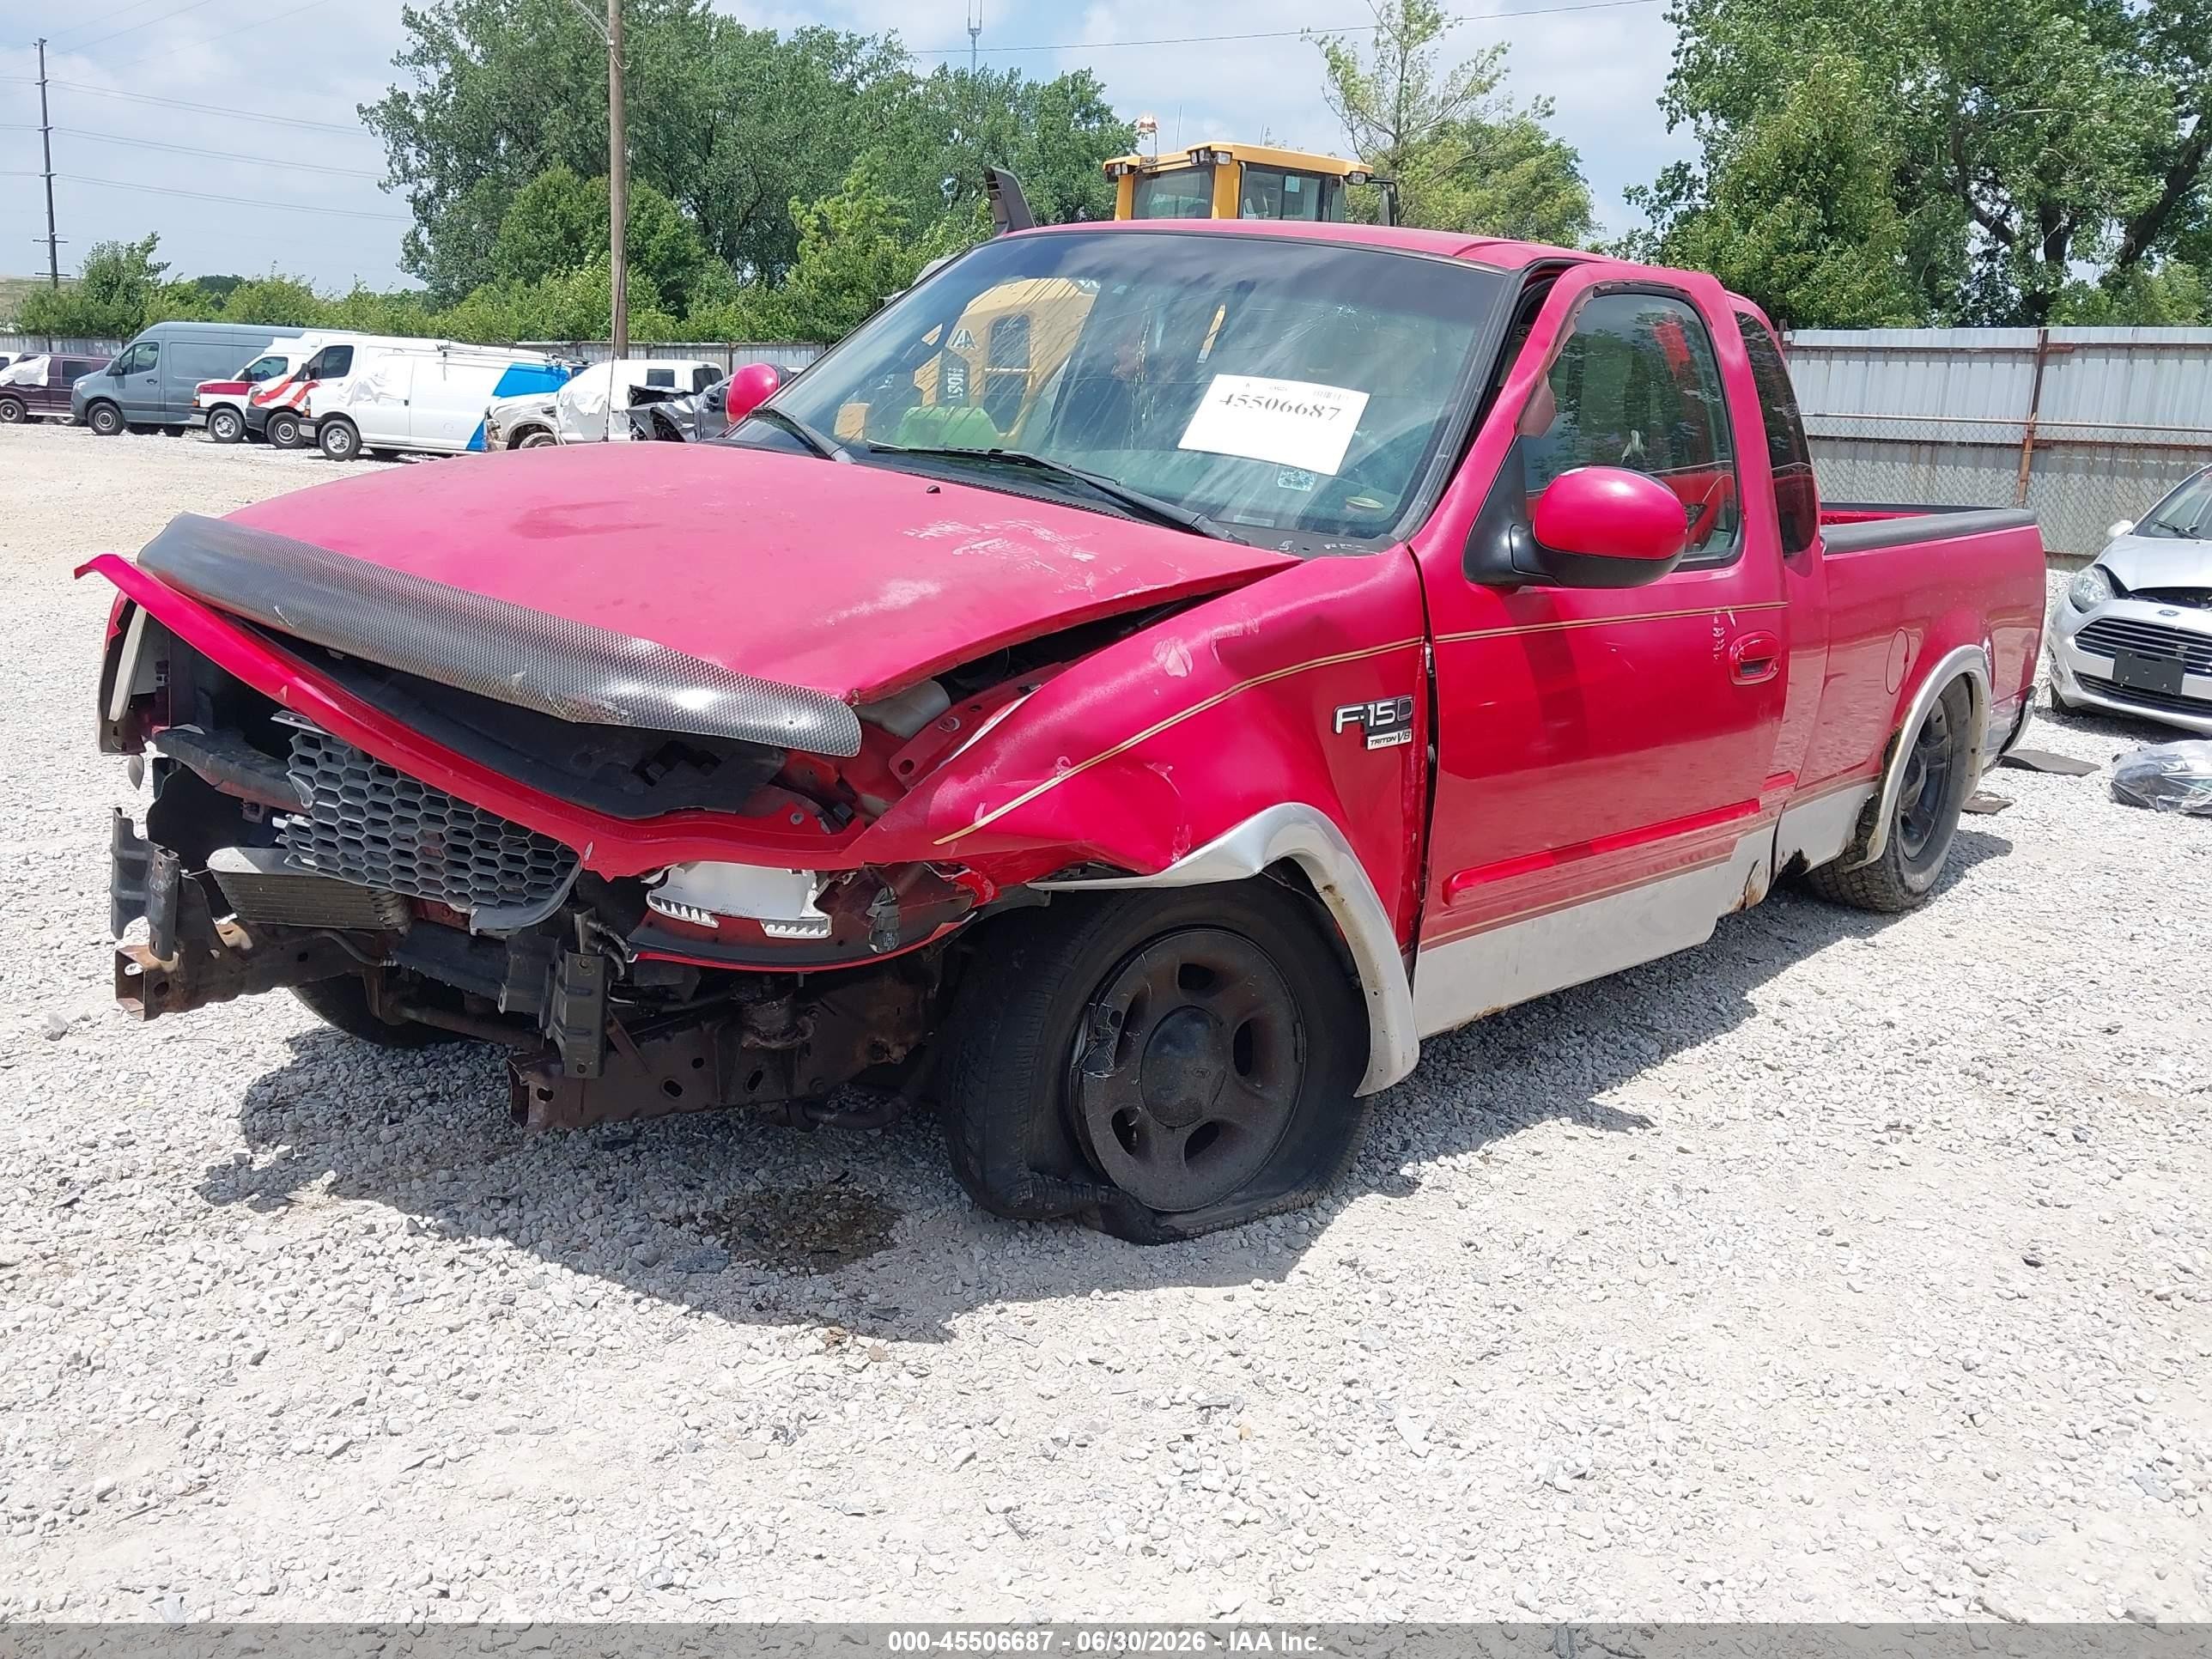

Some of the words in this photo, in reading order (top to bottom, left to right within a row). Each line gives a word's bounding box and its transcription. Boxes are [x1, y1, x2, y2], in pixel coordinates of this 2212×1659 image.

[1219, 393, 1341, 421] 45506687
[1370, 735, 1397, 746] TRITON
[1396, 730, 1411, 743] V8
